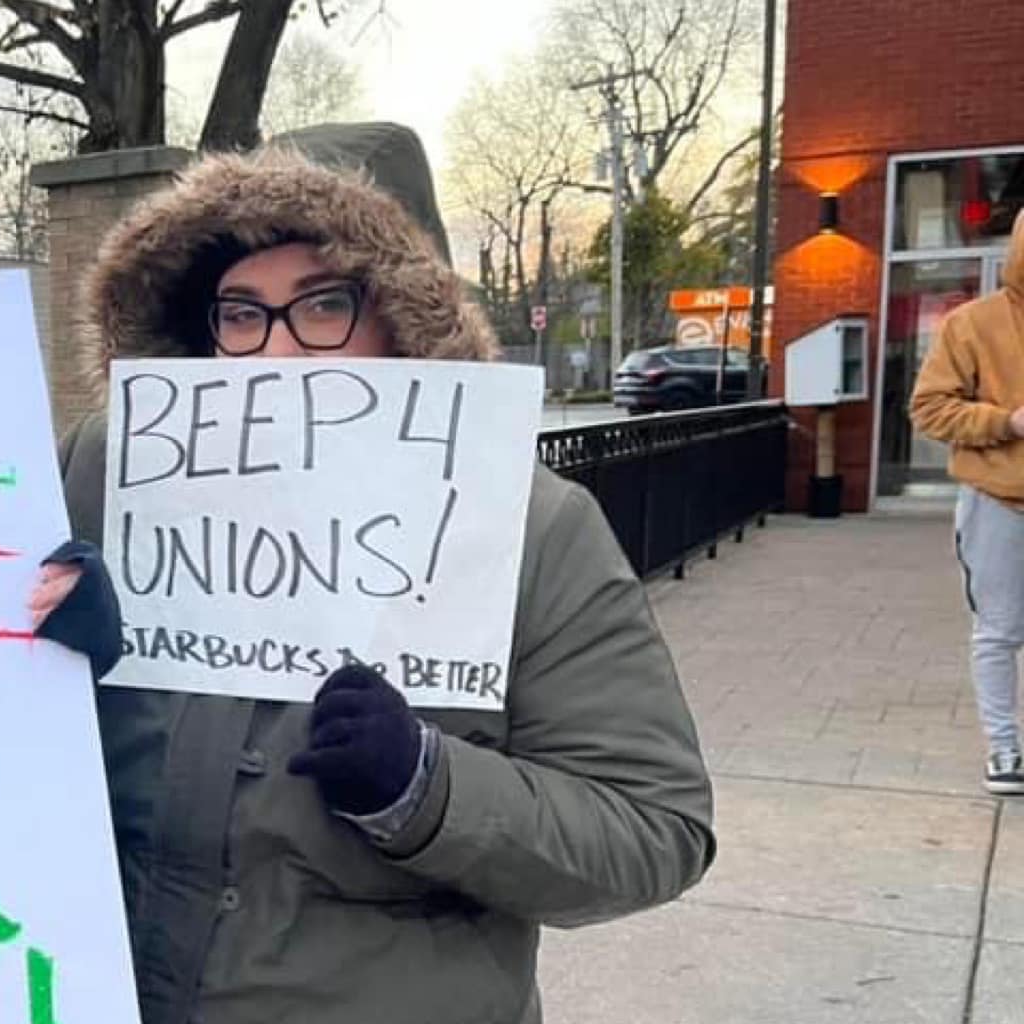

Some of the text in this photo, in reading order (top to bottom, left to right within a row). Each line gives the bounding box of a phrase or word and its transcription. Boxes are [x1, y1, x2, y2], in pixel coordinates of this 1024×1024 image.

[119, 369, 464, 488] BEEP 4
[122, 488, 458, 602] UNIONS!
[400, 653, 504, 700] BETTER
